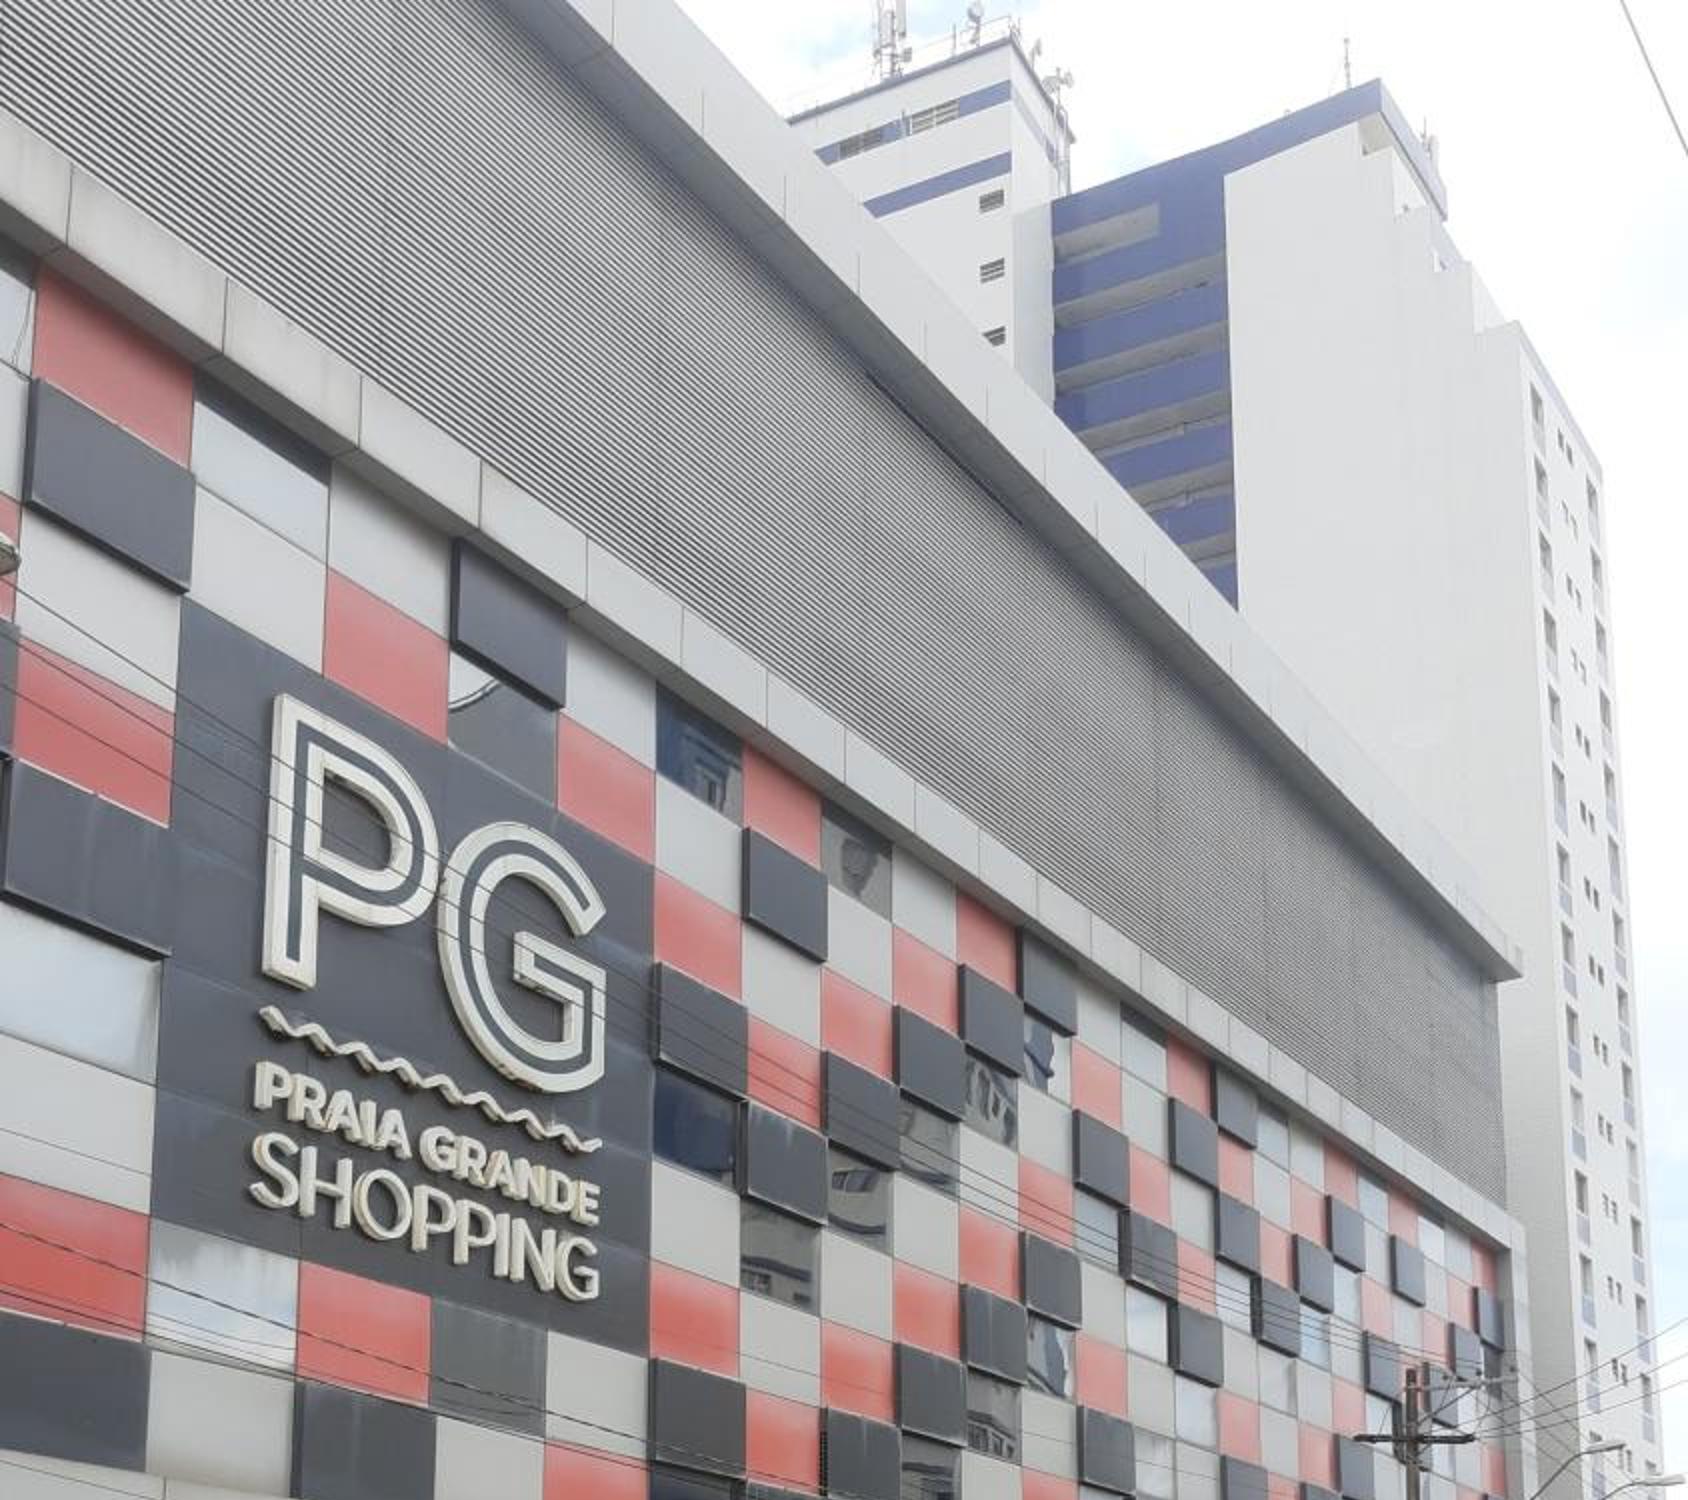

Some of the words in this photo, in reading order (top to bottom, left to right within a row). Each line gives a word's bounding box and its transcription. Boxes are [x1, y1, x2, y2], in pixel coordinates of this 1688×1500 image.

[261, 692, 606, 1093] PG
[249, 1132, 600, 1301] SHOPPING
[254, 1060, 412, 1159] PRAIA
[419, 1126, 600, 1226] GRANDE
